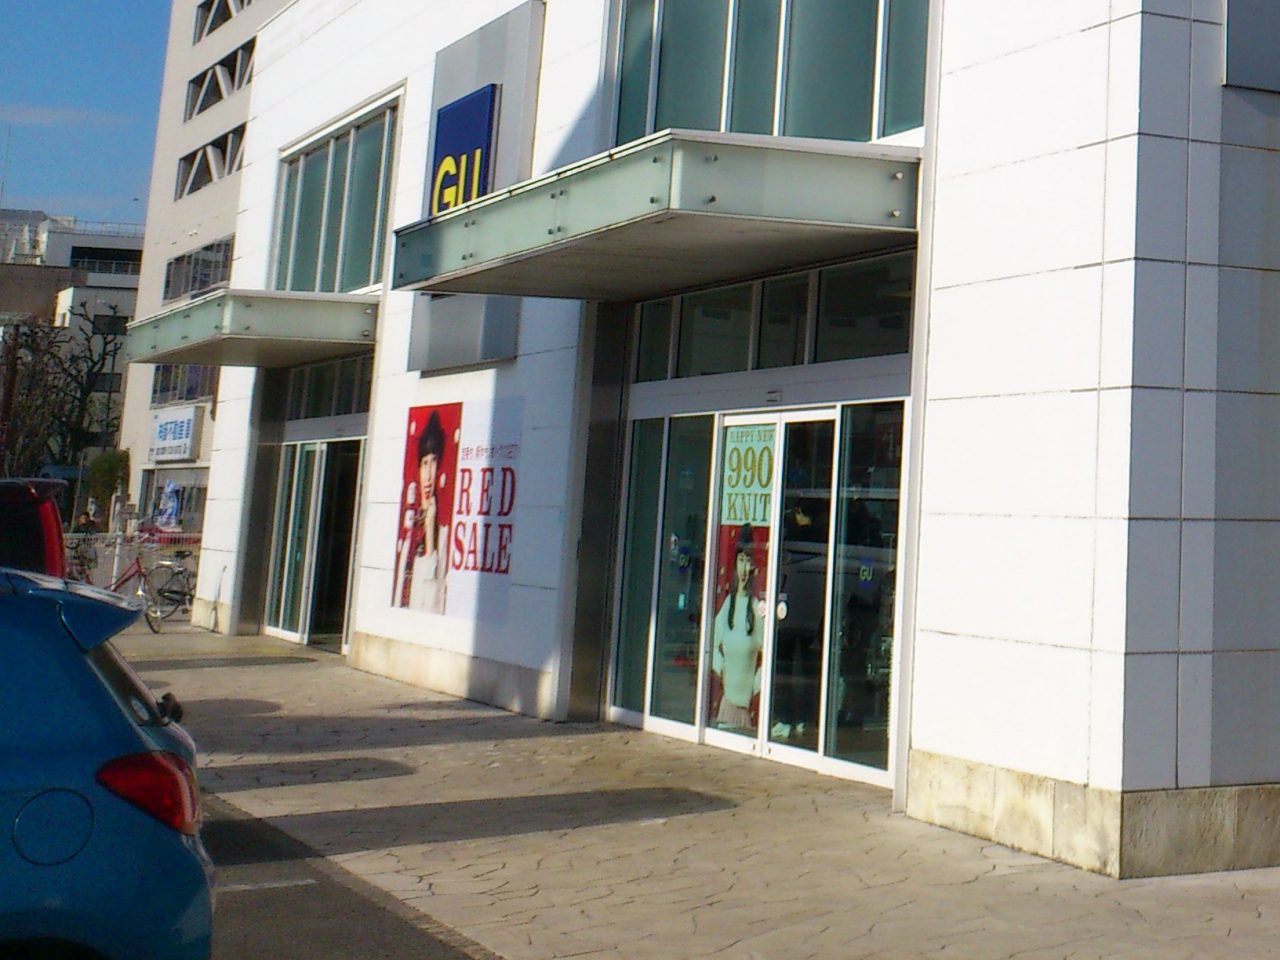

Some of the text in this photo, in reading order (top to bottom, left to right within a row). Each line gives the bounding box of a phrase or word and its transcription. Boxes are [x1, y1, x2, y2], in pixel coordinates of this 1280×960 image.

[432, 148, 482, 216] GU
[727, 445, 774, 488] 990
[456, 467, 516, 517] RED
[726, 493, 771, 521] KNIT
[452, 521, 512, 574] SALE
[860, 566, 873, 581] GU
